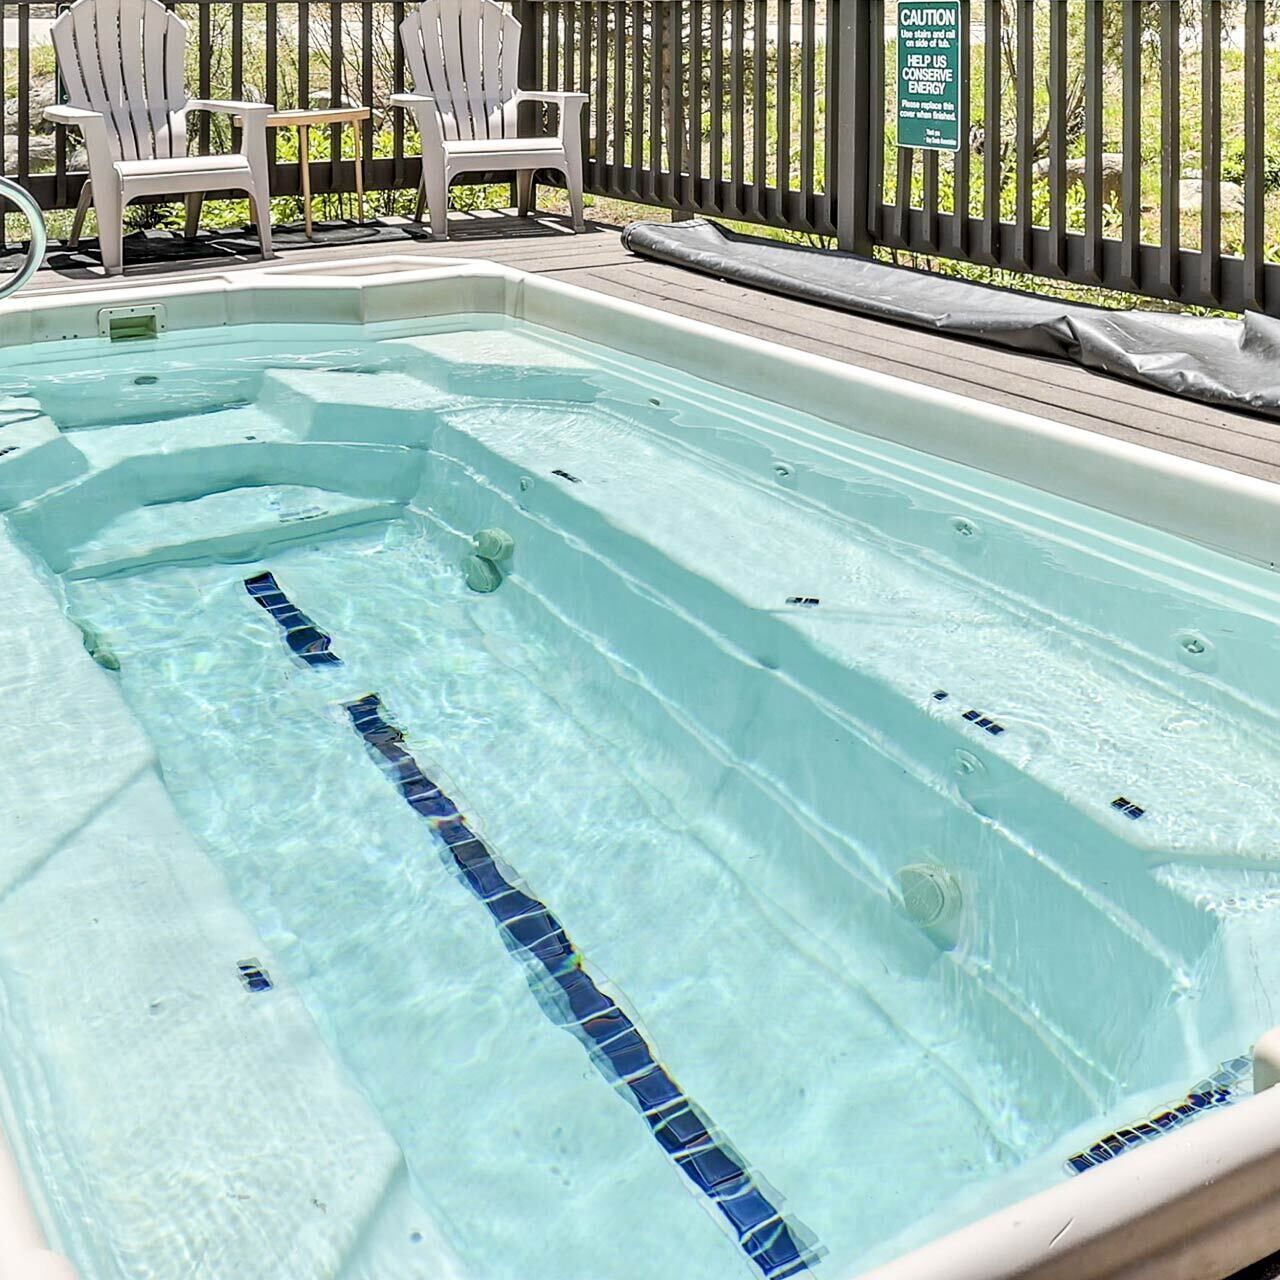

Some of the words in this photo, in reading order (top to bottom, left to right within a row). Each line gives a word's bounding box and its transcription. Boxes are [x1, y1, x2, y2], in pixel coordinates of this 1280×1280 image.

[900, 9, 955, 26] CAUTION
[900, 30, 913, 38] Use
[914, 30, 931, 38] stairs
[933, 30, 944, 38] and
[946, 30, 955, 38] rail
[915, 39, 928, 47] side
[929, 39, 936, 47] of
[908, 54, 931, 67] HELP
[933, 55, 947, 68] US
[902, 68, 953, 82] CONSERVE
[908, 81, 946, 95] ENERGY
[902, 100, 920, 108] Please
[921, 101, 942, 110] replace
[917, 110, 932, 118] when
[933, 111, 956, 120] finished.
